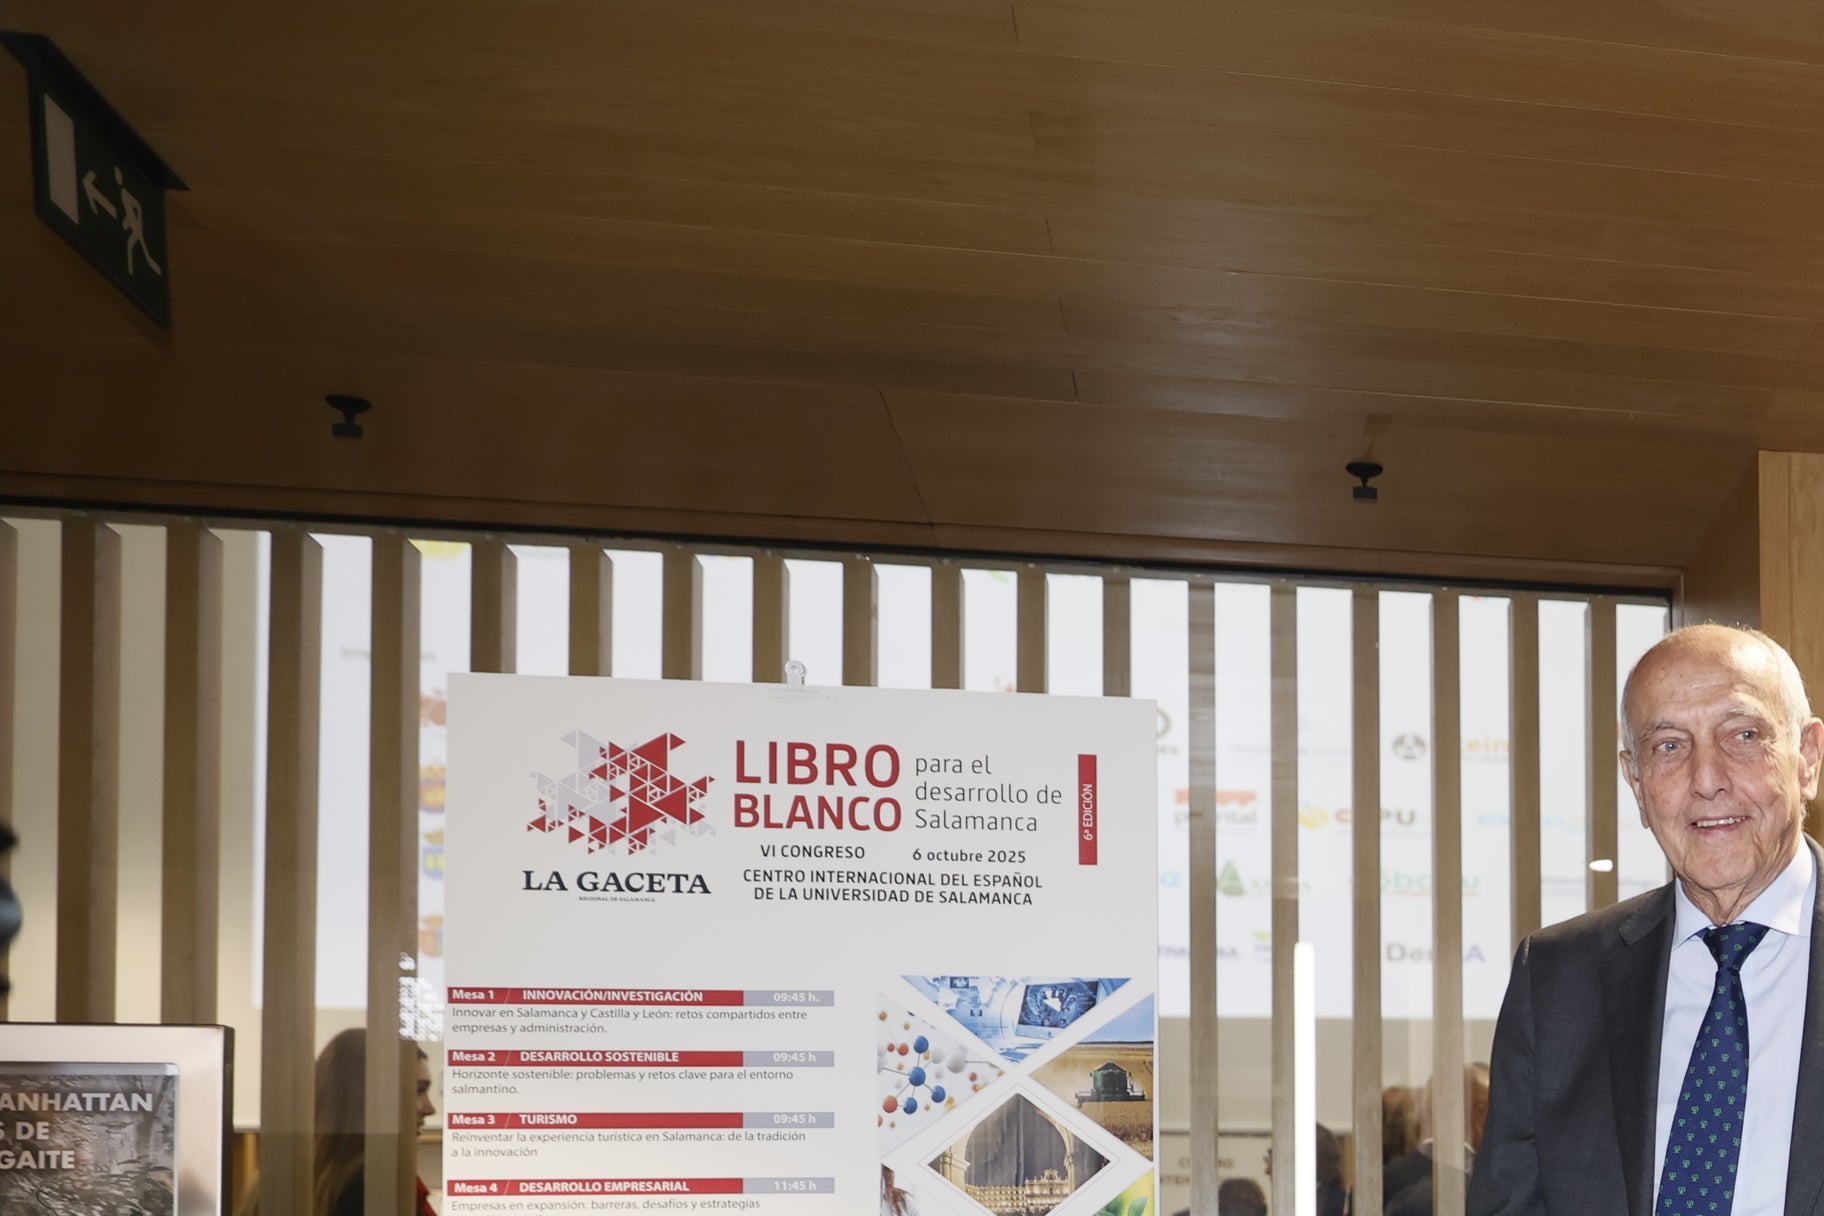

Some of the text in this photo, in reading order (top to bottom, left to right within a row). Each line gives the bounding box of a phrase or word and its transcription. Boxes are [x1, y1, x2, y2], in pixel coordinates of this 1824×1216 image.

[735, 739, 900, 788] LIBRO
[915, 754, 991, 776] para el
[915, 781, 1062, 804] desarrollo de
[1081, 784, 1094, 827] EDICIÓN
[734, 793, 901, 832] BLANCO
[915, 808, 1037, 831] Salamanca
[760, 844, 865, 859] VI CONGRESO
[912, 848, 1025, 863] 6 octubre 2025
[522, 870, 711, 894] LA GACETA
[743, 868, 1042, 888] CENTRO INTERNACIONAL DEL ESPAÑOL
[754, 887, 1032, 905] DE LA UNIVERSIDAD DE SALAMANCA
[452, 989, 494, 999] Mesa 1
[522, 988, 703, 1002] INNOVACIÓN/INVESTIGACIÓN
[773, 992, 806, 1002] 09:45
[452, 1006, 807, 1021] Innovar en Salamanca y Castilla y León: retos compartidos entre
[451, 1022, 606, 1034] empresas y administración.
[452, 1050, 495, 1061] Mesa 2
[520, 1051, 679, 1062] DESARROLLO SOSTENIBLE
[772, 1052, 806, 1062] 09:45
[452, 1068, 793, 1081] Horizonte sostenible: problemas y retos clave para el entorno
[451, 1083, 519, 1094] salmantino.
[451, 1114, 495, 1125] Mesa 3
[519, 1113, 578, 1125] TURISMO
[772, 1113, 806, 1124] 09:45
[16, 1121, 50, 1140] DE
[451, 1130, 805, 1143] Reinventar la experiencia turística en Salamanca: de la tradición
[0, 1150, 76, 1170] GAITE
[453, 1182, 498, 1193] Mesa 4
[519, 1181, 690, 1192] DESARROLLO EMPRESARIAL
[774, 1180, 806, 1191] 11:45
